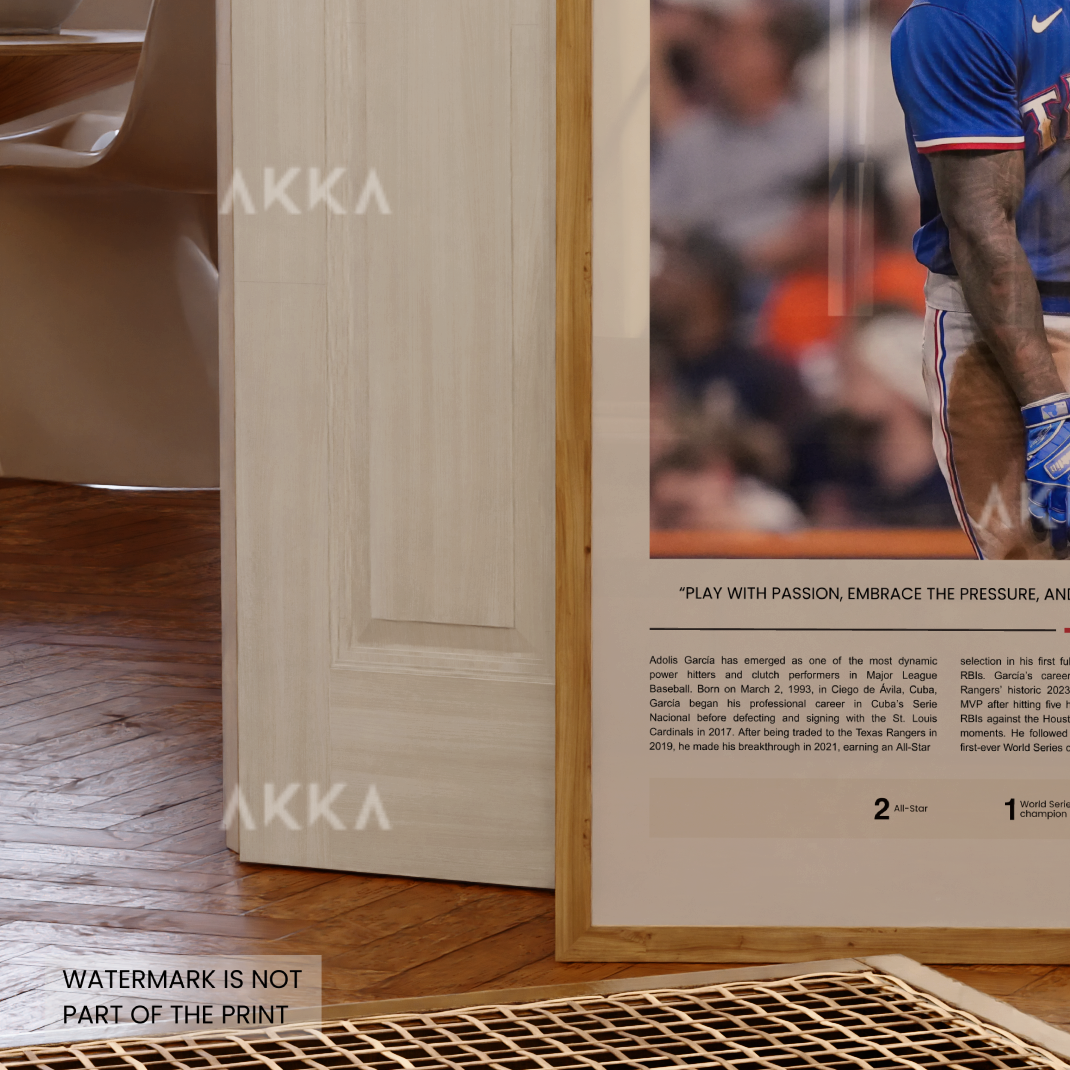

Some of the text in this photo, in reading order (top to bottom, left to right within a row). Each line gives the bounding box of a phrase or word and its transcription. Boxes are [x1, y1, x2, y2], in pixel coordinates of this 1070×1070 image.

[679, 586, 722, 599] “PLAY
[727, 586, 766, 599] WITH
[772, 586, 843, 602] PASSION,
[847, 587, 921, 600] EMBRACE
[926, 587, 954, 600] THE
[960, 587, 1039, 602] PRESSURE,
[649, 655, 937, 667] Adolis García has emerged as one of the most dynamic
[960, 656, 1001, 665] selection
[1006, 656, 1014, 665] in
[1019, 656, 1033, 665] his
[1037, 656, 1055, 665] first
[649, 684, 692, 693] Baseball.
[697, 684, 719, 693] Born
[740, 684, 769, 693] March
[774, 684, 783, 694] 2,
[788, 684, 813, 694] 1993,
[818, 684, 826, 693] in
[831, 684, 858, 695] Ciego
[863, 685, 875, 693] de
[879, 683, 904, 694] Ávila,
[909, 684, 937, 695] Cuba,
[649, 741, 675, 751] 2019,
[678, 741, 690, 750] he
[692, 742, 719, 750] made
[722, 741, 735, 750] his
[738, 742, 800, 753] breakthrough
[803, 742, 811, 750] in
[814, 742, 840, 751] 2021,
[842, 742, 878, 753] earning
[895, 742, 930, 751] All-Star
[960, 742, 1000, 751] first-ever
[1002, 743, 1030, 751] World
[1033, 742, 1063, 752] Series
[874, 797, 928, 820] 2 All-Star
[1004, 798, 1015, 820] 1
[1019, 800, 1047, 808] World
[1019, 809, 1067, 820] champion
